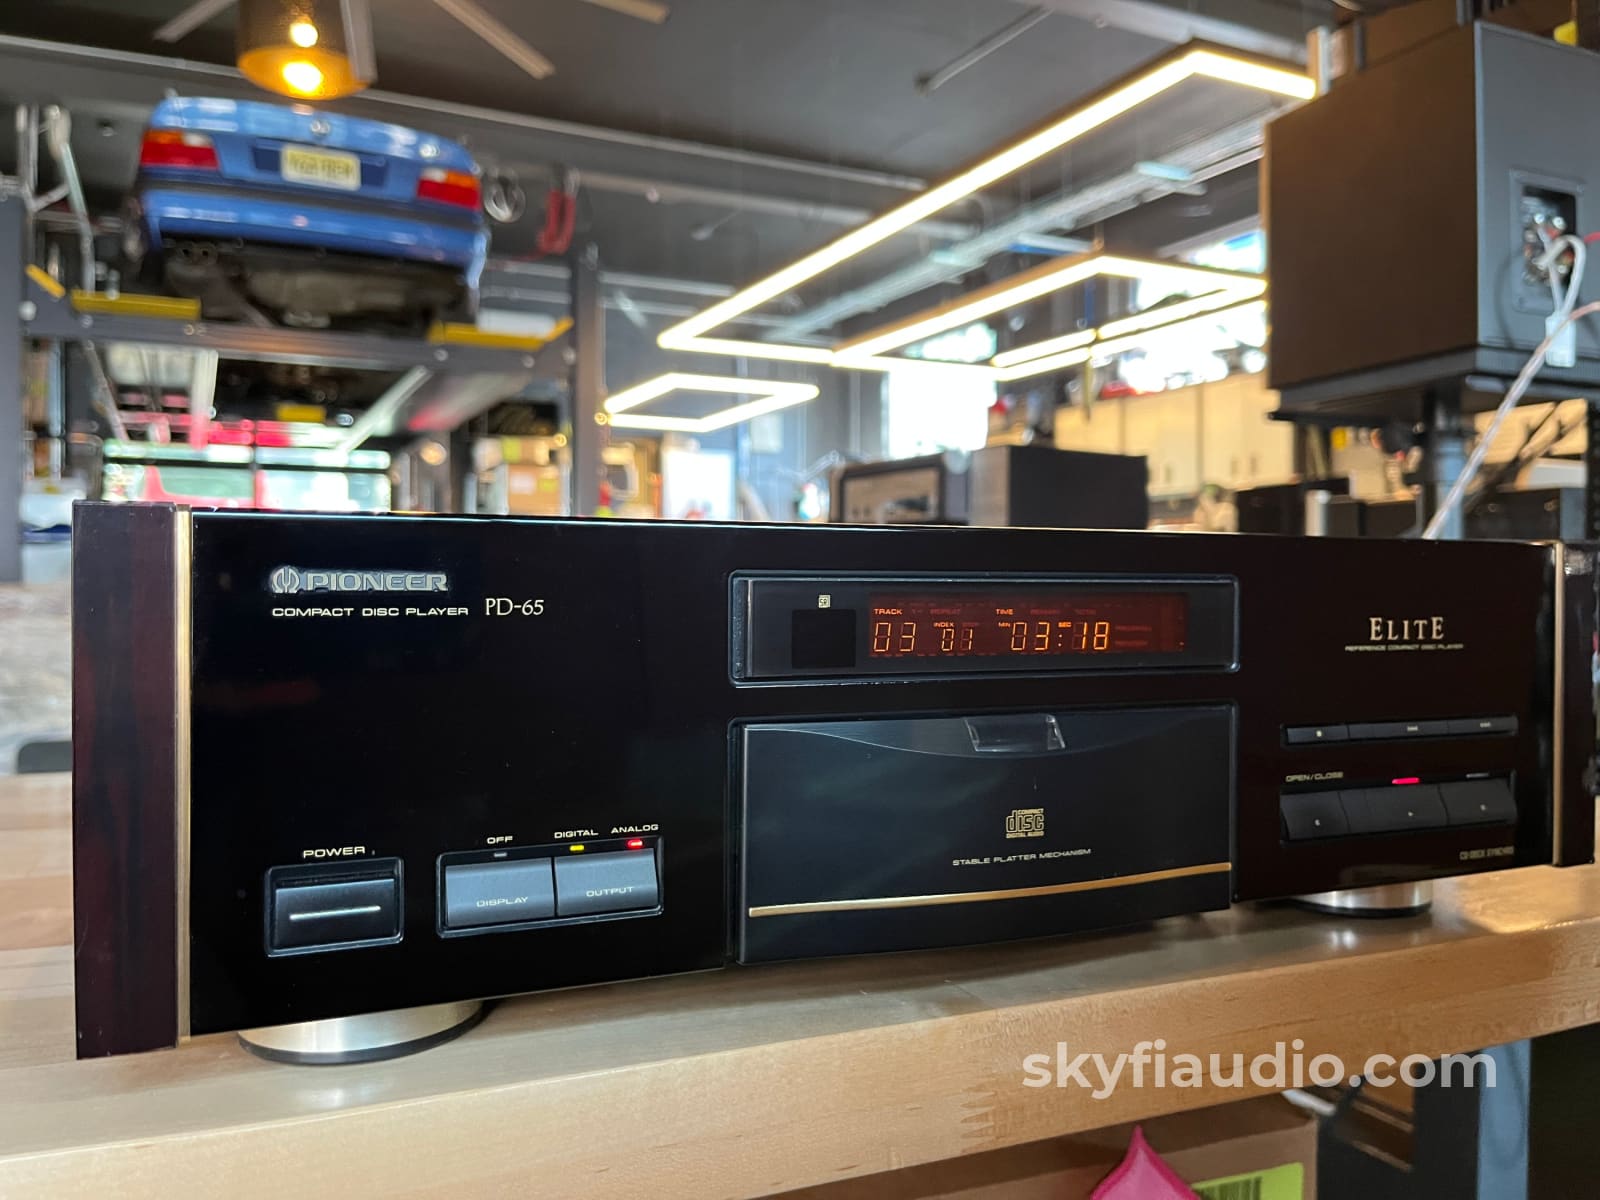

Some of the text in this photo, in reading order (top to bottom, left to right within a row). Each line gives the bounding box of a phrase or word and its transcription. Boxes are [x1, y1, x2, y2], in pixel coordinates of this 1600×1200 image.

[306, 570, 449, 592] PIONEER
[271, 606, 469, 617] COMPACT DISC PLAYER
[484, 597, 545, 616] PD-65
[873, 608, 903, 616] TRACK
[995, 608, 1014, 616] TIME
[933, 621, 955, 629] INDEX
[1368, 616, 1444, 641] ELITE
[873, 621, 917, 652] 03
[1285, 771, 1344, 782] OPEN/CLOSE
[554, 828, 598, 838] DIGITAL
[611, 824, 659, 834] ANALOG
[487, 835, 513, 845] OFF
[302, 846, 366, 858] POWER
[952, 848, 1092, 866] STABLE PLATTER MECHANISM
[585, 886, 634, 898] OUTPUT
[476, 896, 529, 908] DISPLAY
